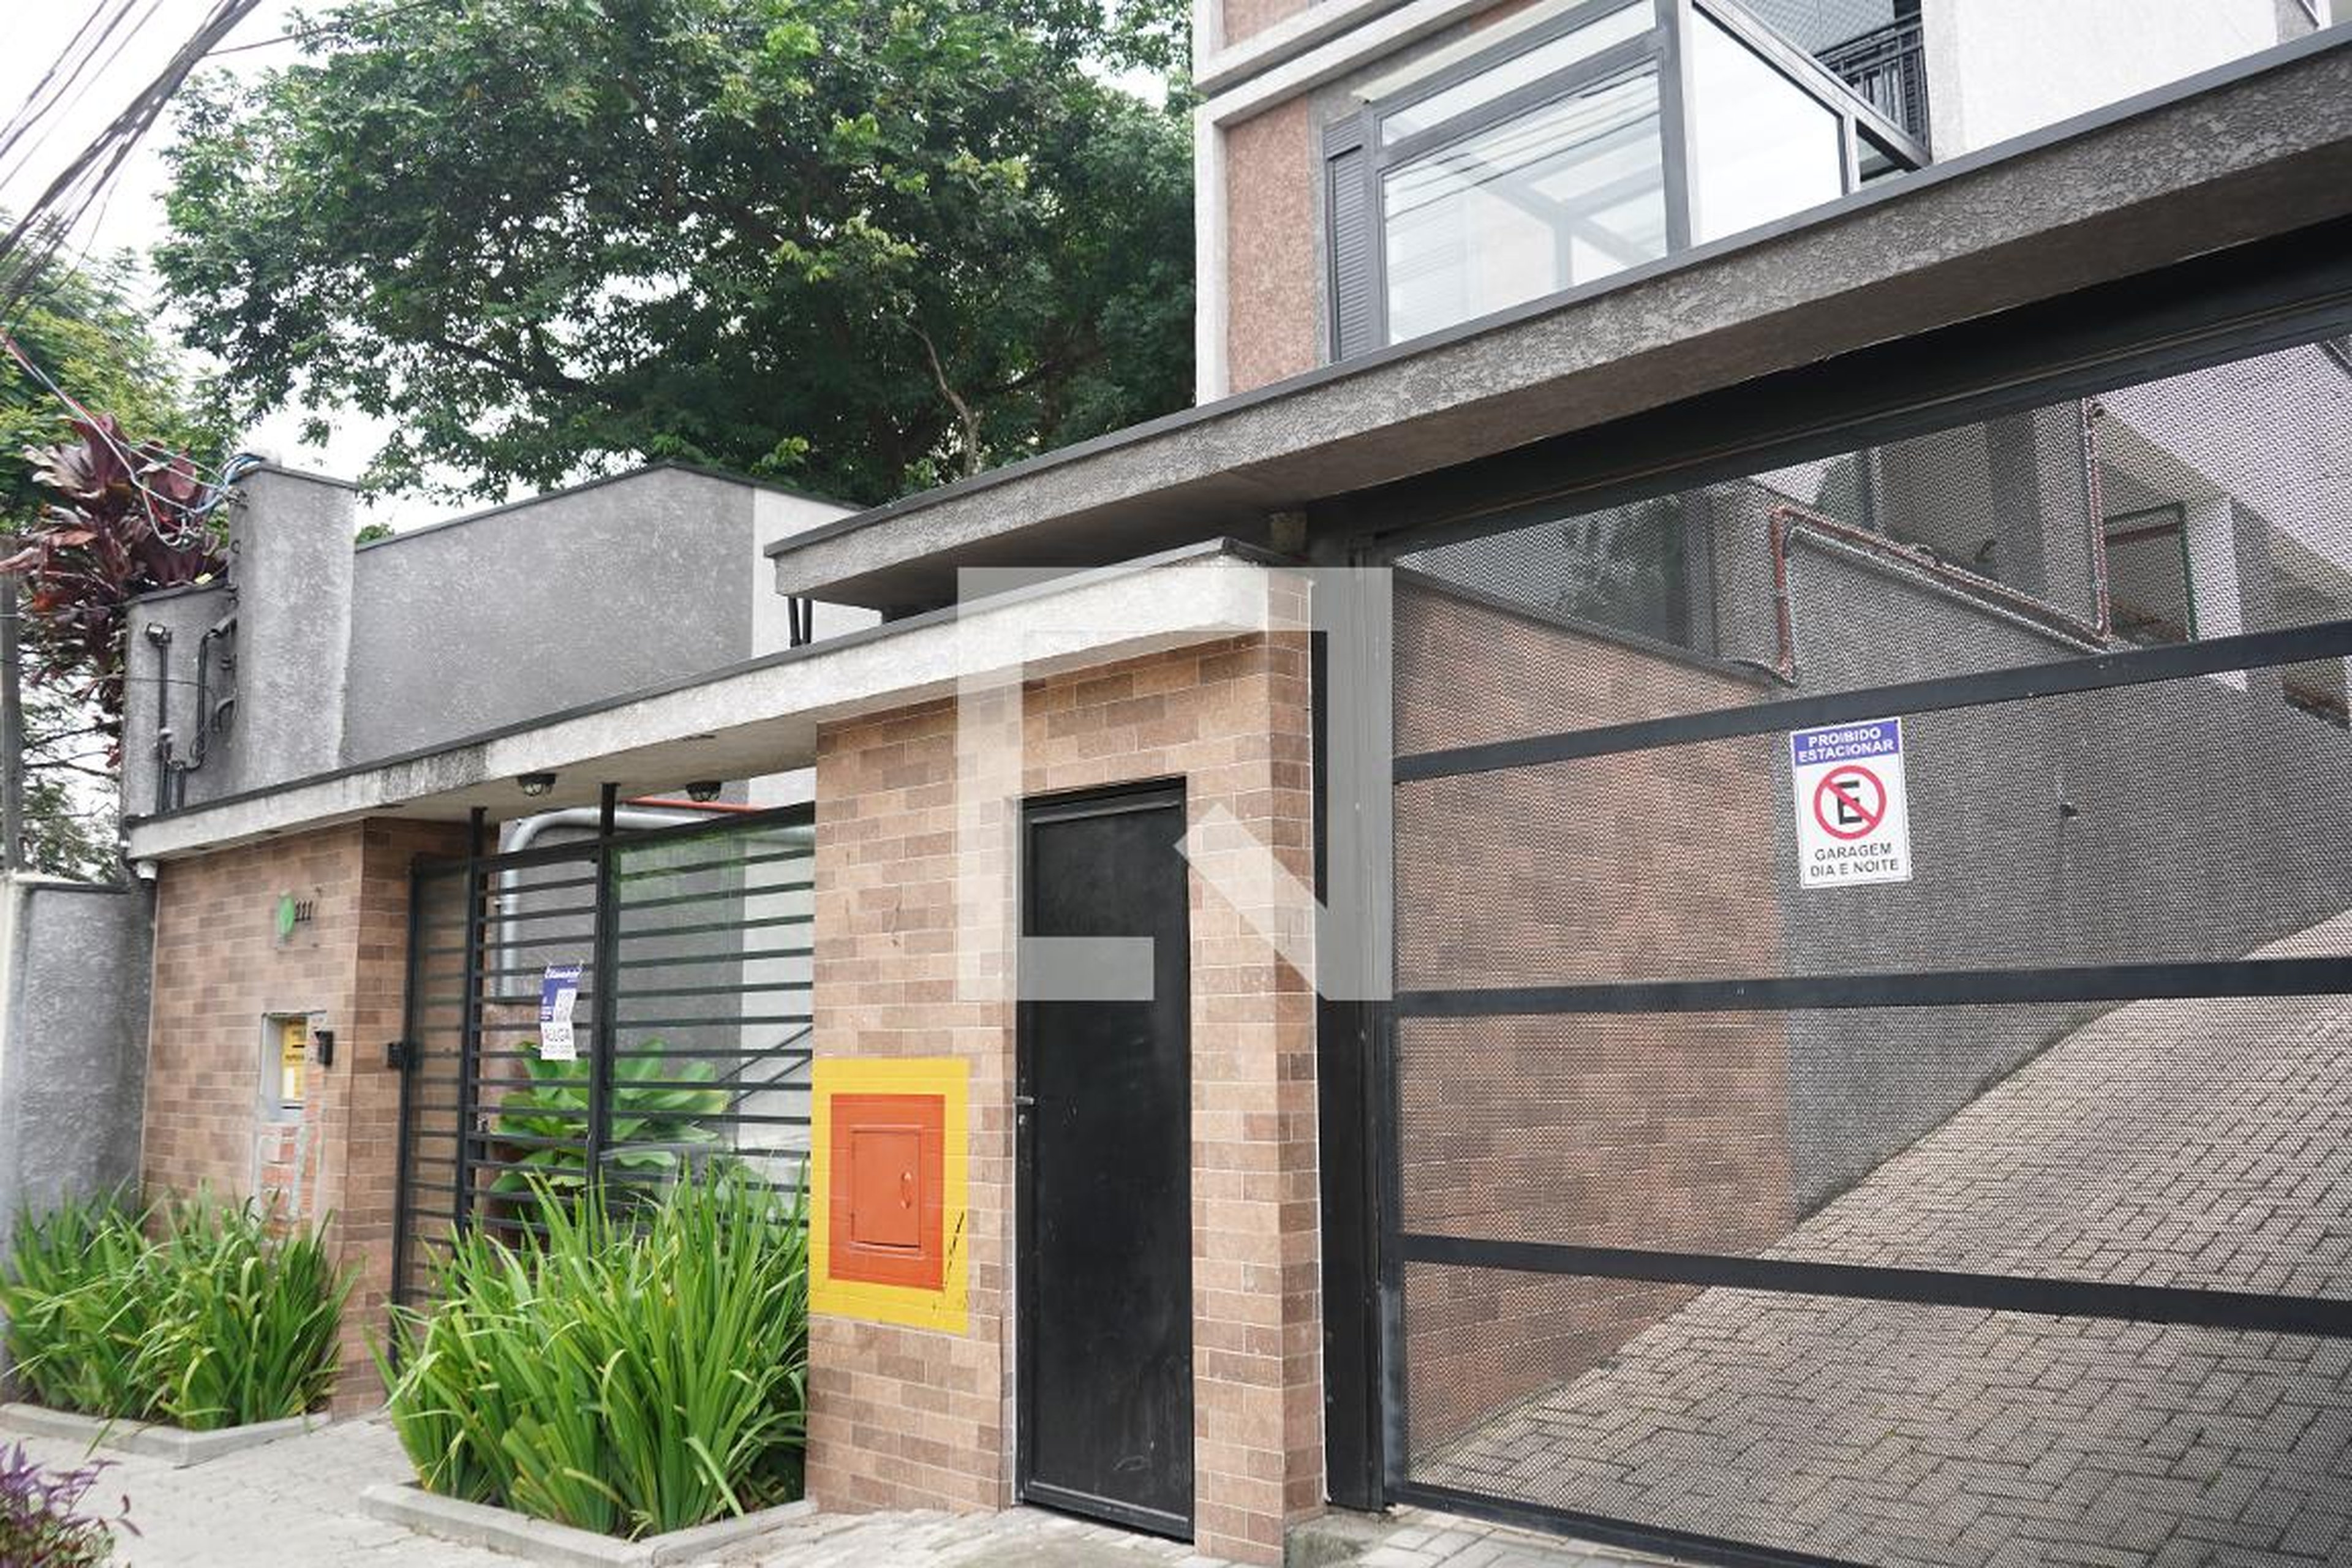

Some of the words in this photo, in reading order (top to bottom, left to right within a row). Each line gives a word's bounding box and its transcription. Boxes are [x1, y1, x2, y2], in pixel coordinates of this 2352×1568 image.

[1809, 727, 1881, 748] PROIBIDO
[1798, 739, 1894, 762] ESTACIONAR
[1837, 780, 1862, 824] E
[1815, 843, 1891, 861] GARAGEM
[1811, 865, 1835, 877] DIA
[1840, 863, 1849, 875] E
[1853, 859, 1899, 873] NOITE
